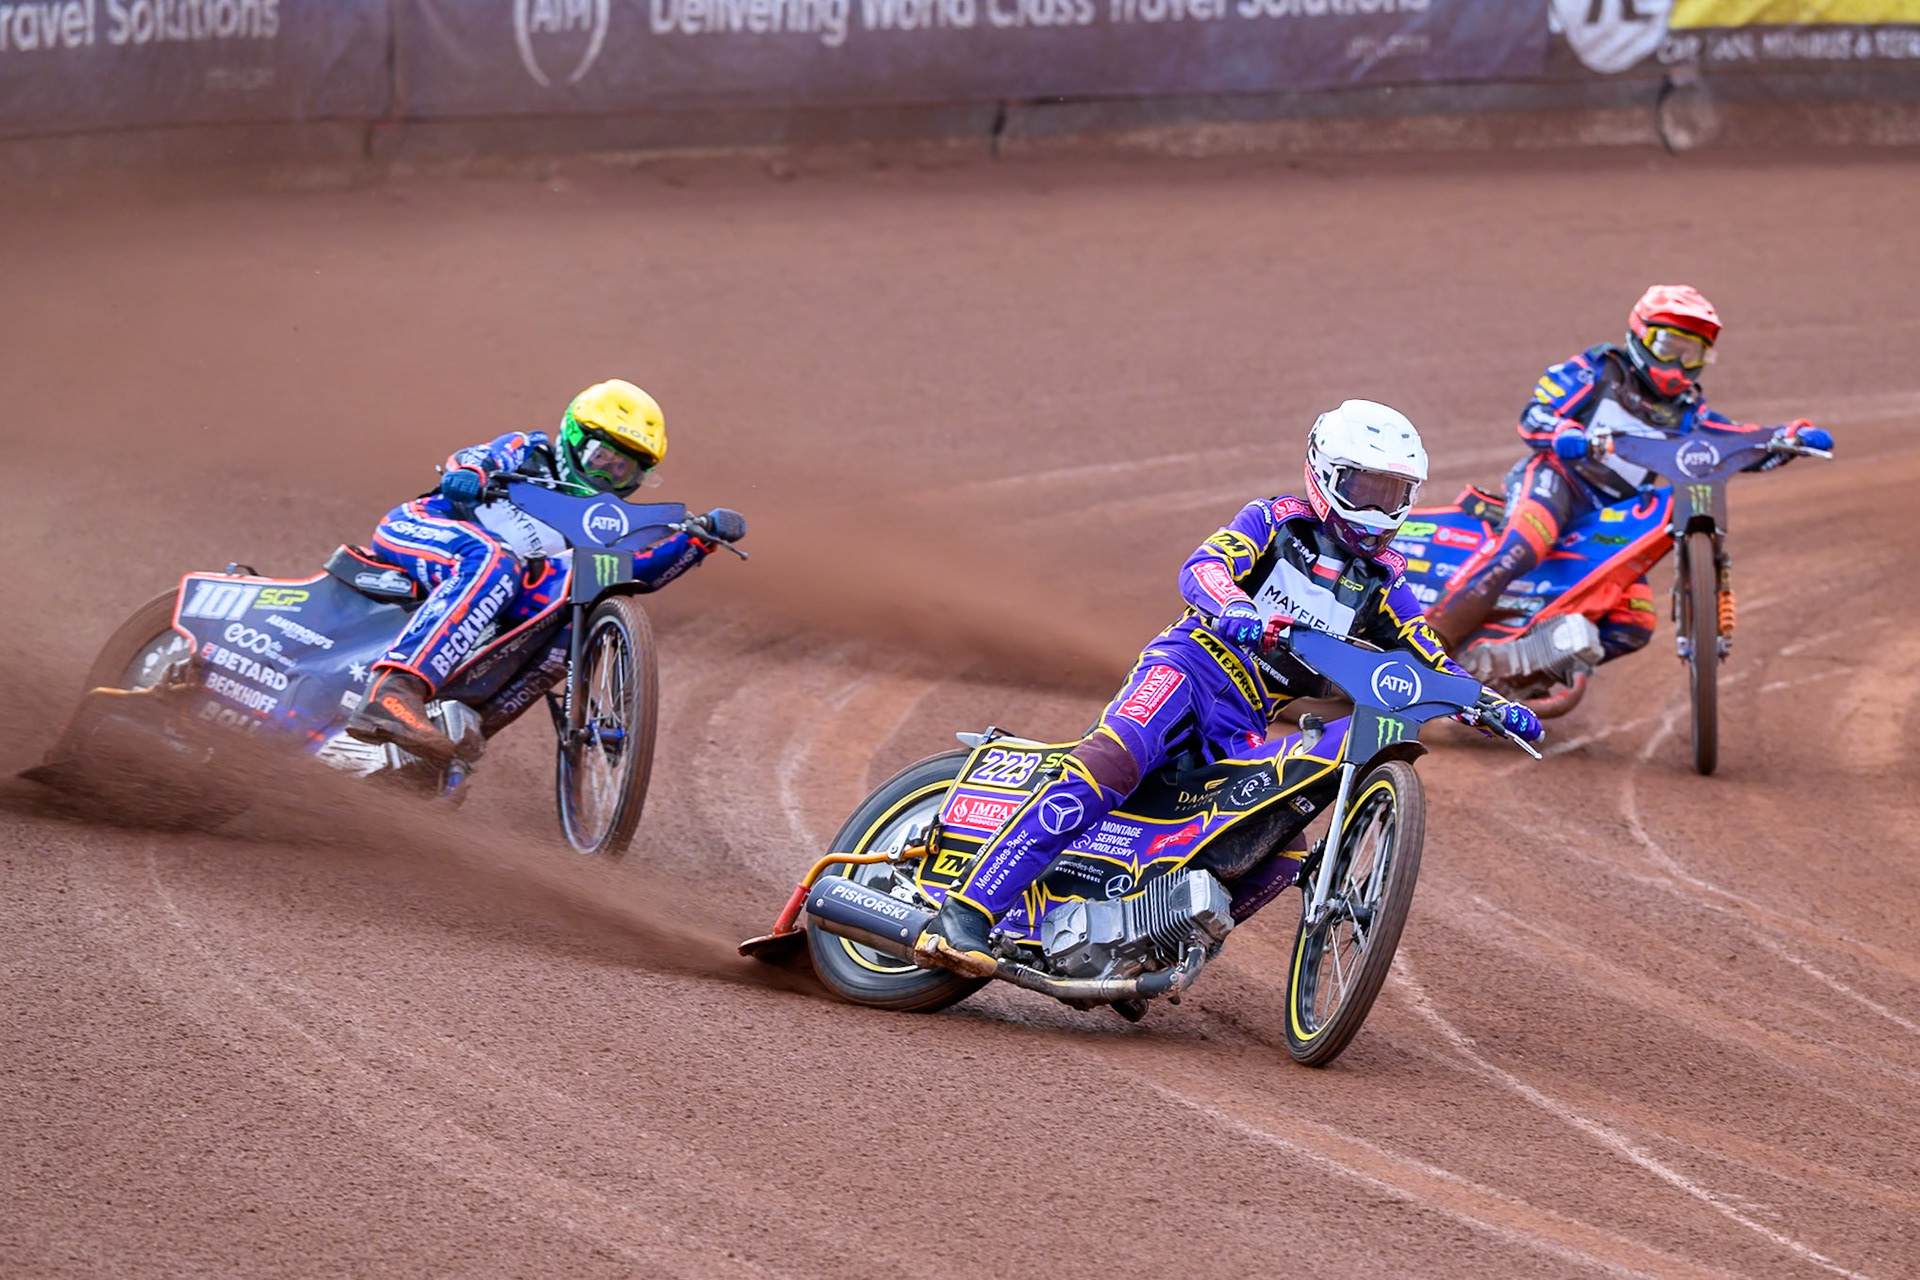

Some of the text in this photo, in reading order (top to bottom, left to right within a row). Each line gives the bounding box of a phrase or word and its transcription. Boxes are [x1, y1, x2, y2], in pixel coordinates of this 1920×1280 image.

[590, 516, 621, 532] ATPI
[182, 581, 310, 620] 101 SGP
[430, 573, 513, 678] BECKHOFF
[213, 648, 288, 690] BETARD
[1221, 656, 1261, 706] EXPRESS
[1379, 674, 1414, 696] ATPI
[204, 671, 278, 714] BECKHOFF
[966, 748, 1043, 789] 223
[1095, 833, 1133, 848] SERVICE
[1100, 820, 1143, 838] MONTAGE
[975, 829, 1029, 890] Mercedes-Benz
[986, 868, 1010, 896] GRUPA
[831, 885, 910, 920] PISKORSKI
